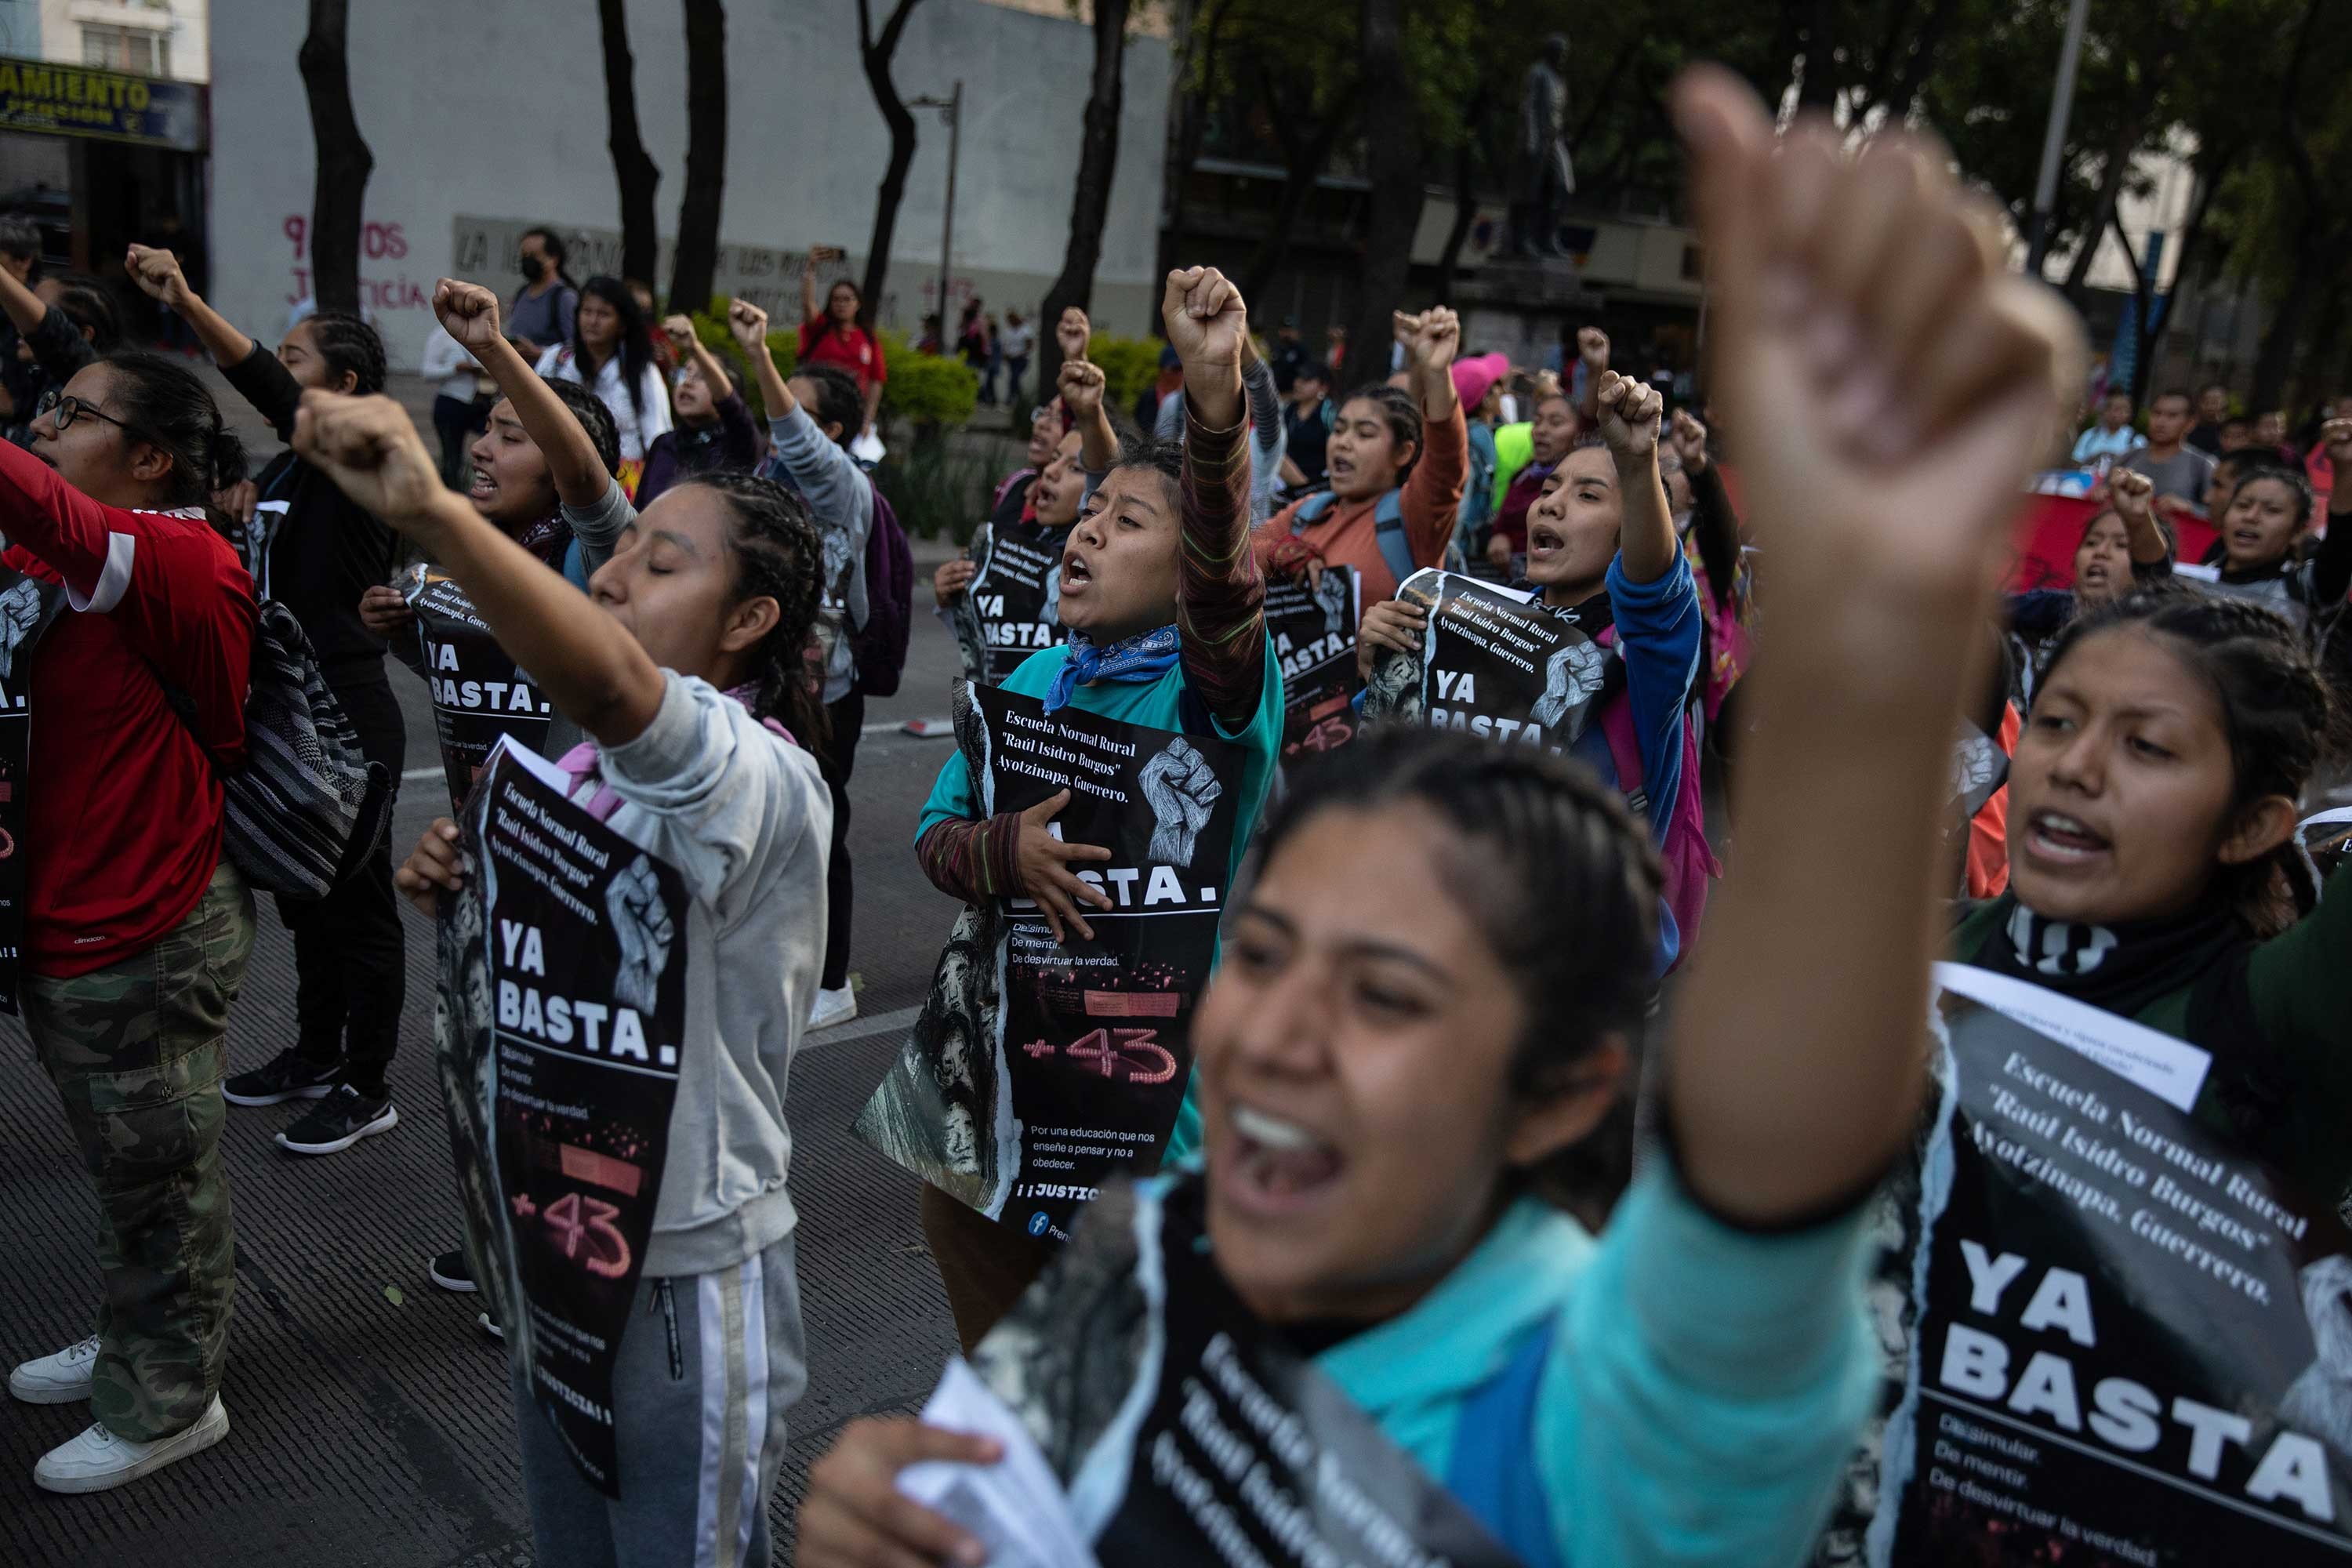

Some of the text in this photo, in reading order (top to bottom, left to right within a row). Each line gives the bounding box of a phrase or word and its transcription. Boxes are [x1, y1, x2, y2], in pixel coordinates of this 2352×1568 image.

[976, 594, 1004, 618] YA
[1450, 602, 1541, 653] "Raúl Isidro Burgos"
[1459, 591, 1494, 612] Escuela
[1493, 605, 1530, 629] Normal
[1528, 622, 1559, 644] Rural
[427, 641, 459, 671] YA
[1281, 631, 1356, 679] ASTA.
[1437, 615, 1535, 673] Ayotzinapa, Guerrero.
[430, 676, 550, 713] BASTA.
[1436, 669, 1475, 703] YA
[1002, 731, 1121, 776] "Raúl Isidro Burgos"
[1005, 710, 1136, 757] Escuela Normal Rural
[996, 754, 1129, 804] Ayotzinapa, Guerrero.
[503, 781, 610, 870] Escuela Normal Rural
[520, 826, 553, 859] Isidro
[500, 917, 546, 978] YA
[1012, 937, 1023, 947] De
[1013, 954, 1120, 967] De desvirtuar la verdad.
[499, 978, 677, 1066] BASTA.
[1031, 1125, 1155, 1142] Por una educación que nos
[1033, 1142, 1065, 1152] enseñe
[1074, 1145, 1105, 1156] pensar
[1106, 1148, 1113, 1158] y
[1127, 1149, 1134, 1158] a
[2002, 1051, 2309, 1243] Escuela Normal Rural
[2061, 1124, 2147, 1189] Isidro
[1033, 1157, 1076, 1170] obedecer.
[2129, 1208, 2270, 1307] Guerrero.
[1961, 1239, 2096, 1348] YA
[1939, 1322, 2336, 1524] BASTA
[1933, 1437, 1961, 1465] De
[1929, 1466, 1958, 1491] De
[1959, 1479, 2058, 1530] desvirtuar
[2060, 1515, 2079, 1540] la
